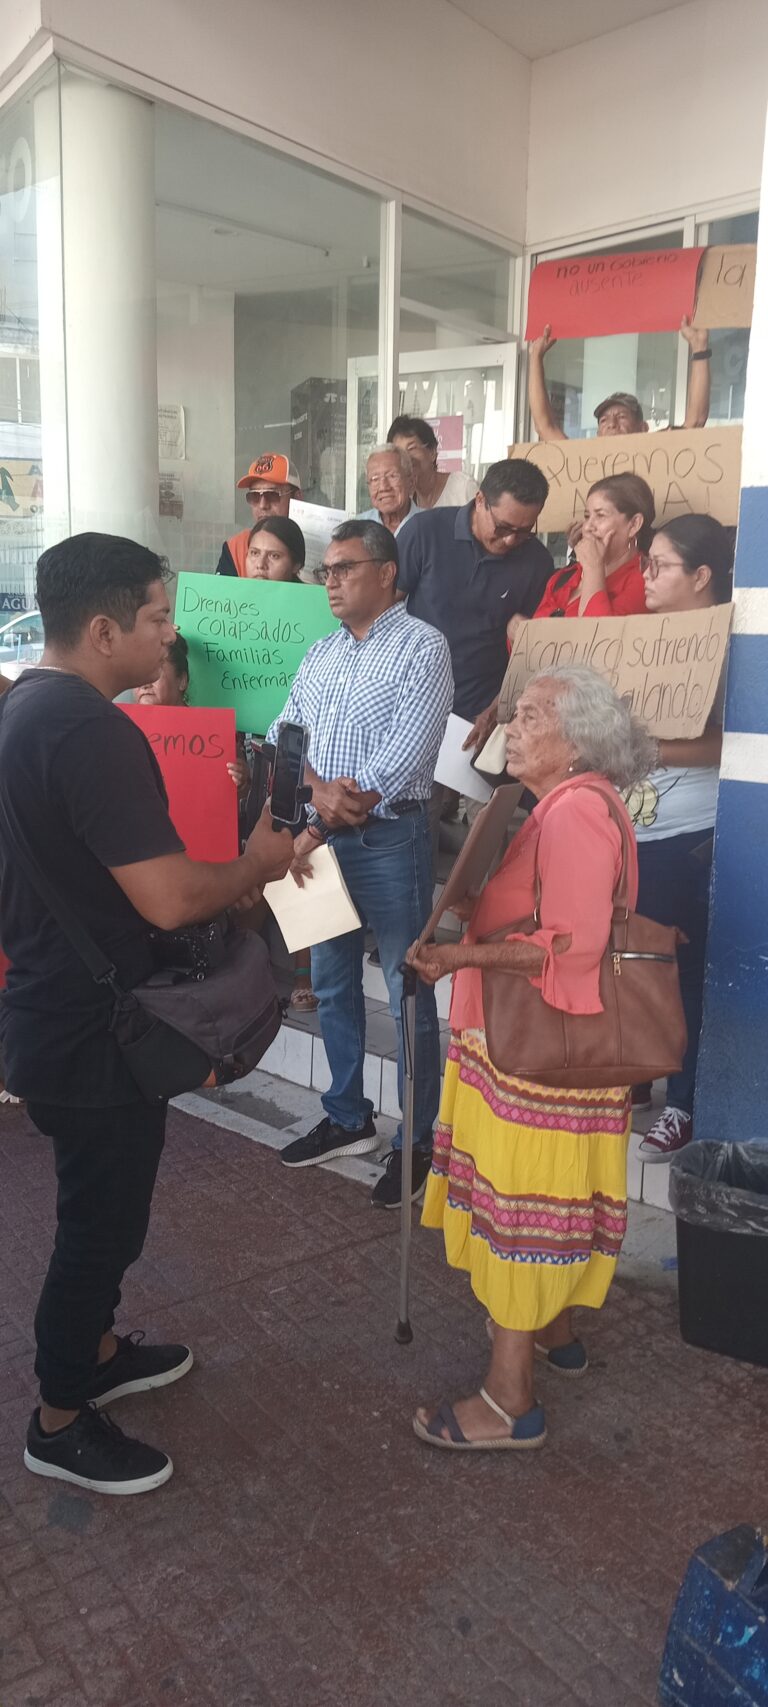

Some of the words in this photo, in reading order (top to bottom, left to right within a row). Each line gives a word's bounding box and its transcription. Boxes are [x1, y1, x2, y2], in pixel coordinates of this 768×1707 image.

[556, 264, 580, 279] no
[587, 261, 605, 274] un
[715, 254, 748, 288] la
[525, 440, 724, 488] Queremos
[182, 586, 260, 617] Drenajes
[203, 641, 285, 666] Familias
[627, 616, 721, 668] sufriendo
[146, 732, 226, 759] emos
